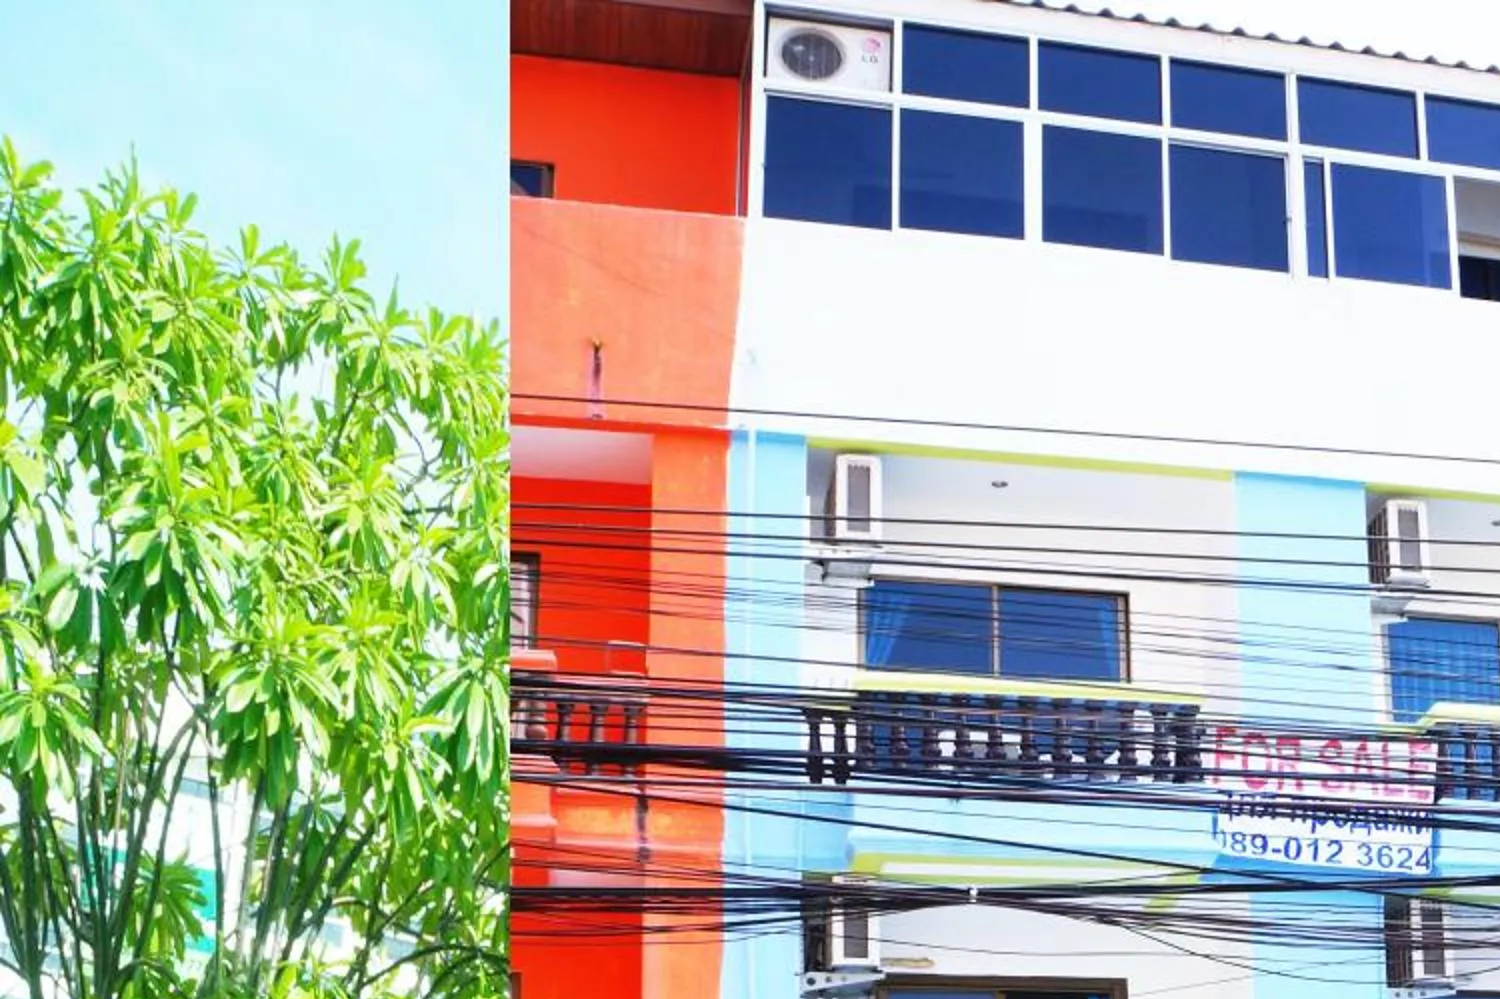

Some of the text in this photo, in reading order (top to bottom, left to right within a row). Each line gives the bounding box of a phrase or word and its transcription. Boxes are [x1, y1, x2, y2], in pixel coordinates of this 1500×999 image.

[1212, 726, 1435, 801] FOR SALE
[1356, 842, 1431, 872] 3624
